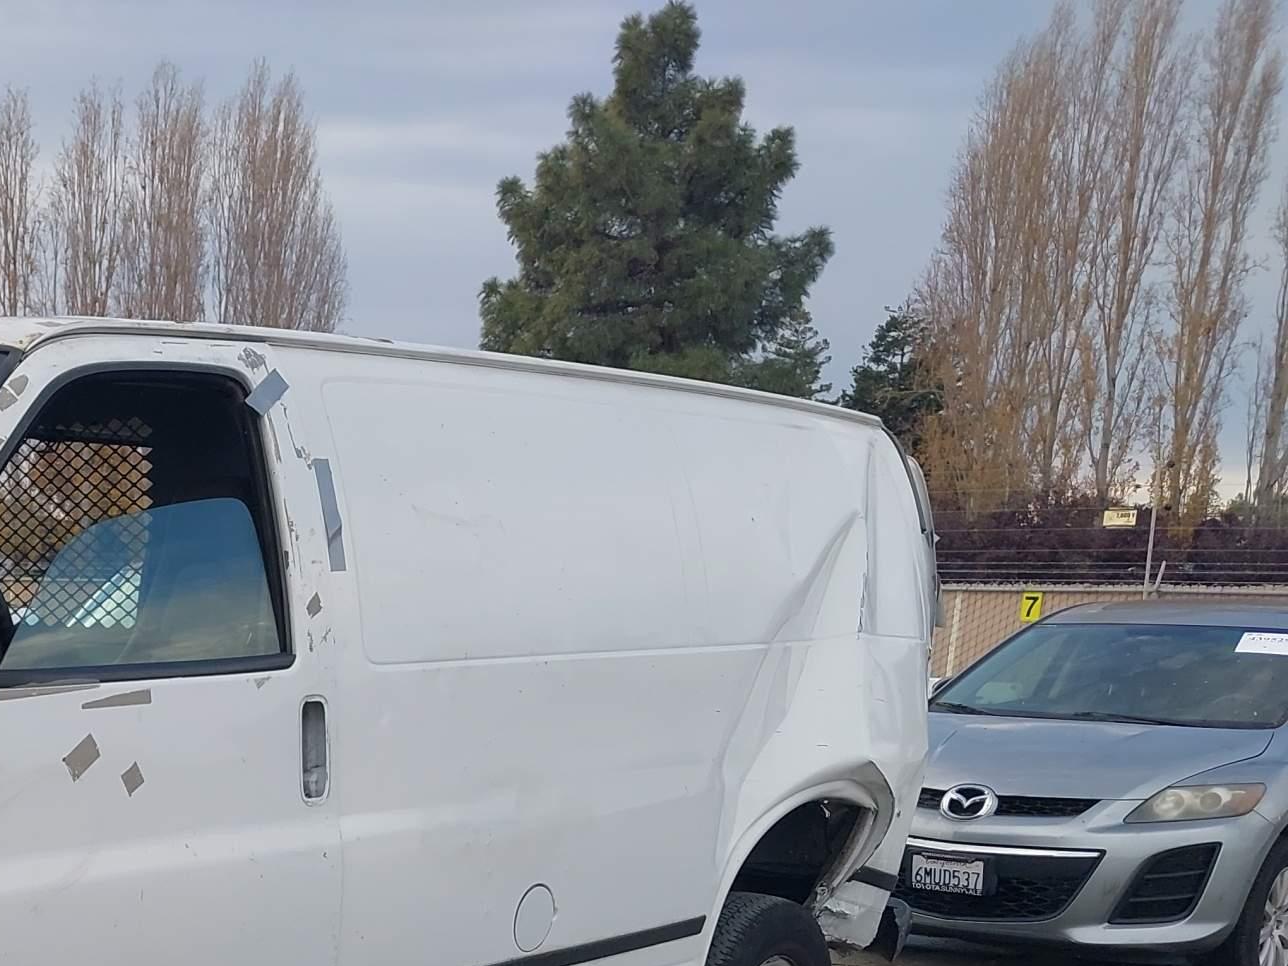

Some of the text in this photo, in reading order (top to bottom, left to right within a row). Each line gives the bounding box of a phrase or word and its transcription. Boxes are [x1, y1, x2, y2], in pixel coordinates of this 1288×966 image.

[1025, 596, 1039, 617] 7
[914, 866, 981, 890] 6MUD537
[912, 882, 983, 897] TOYOTA SUNNYVALE
